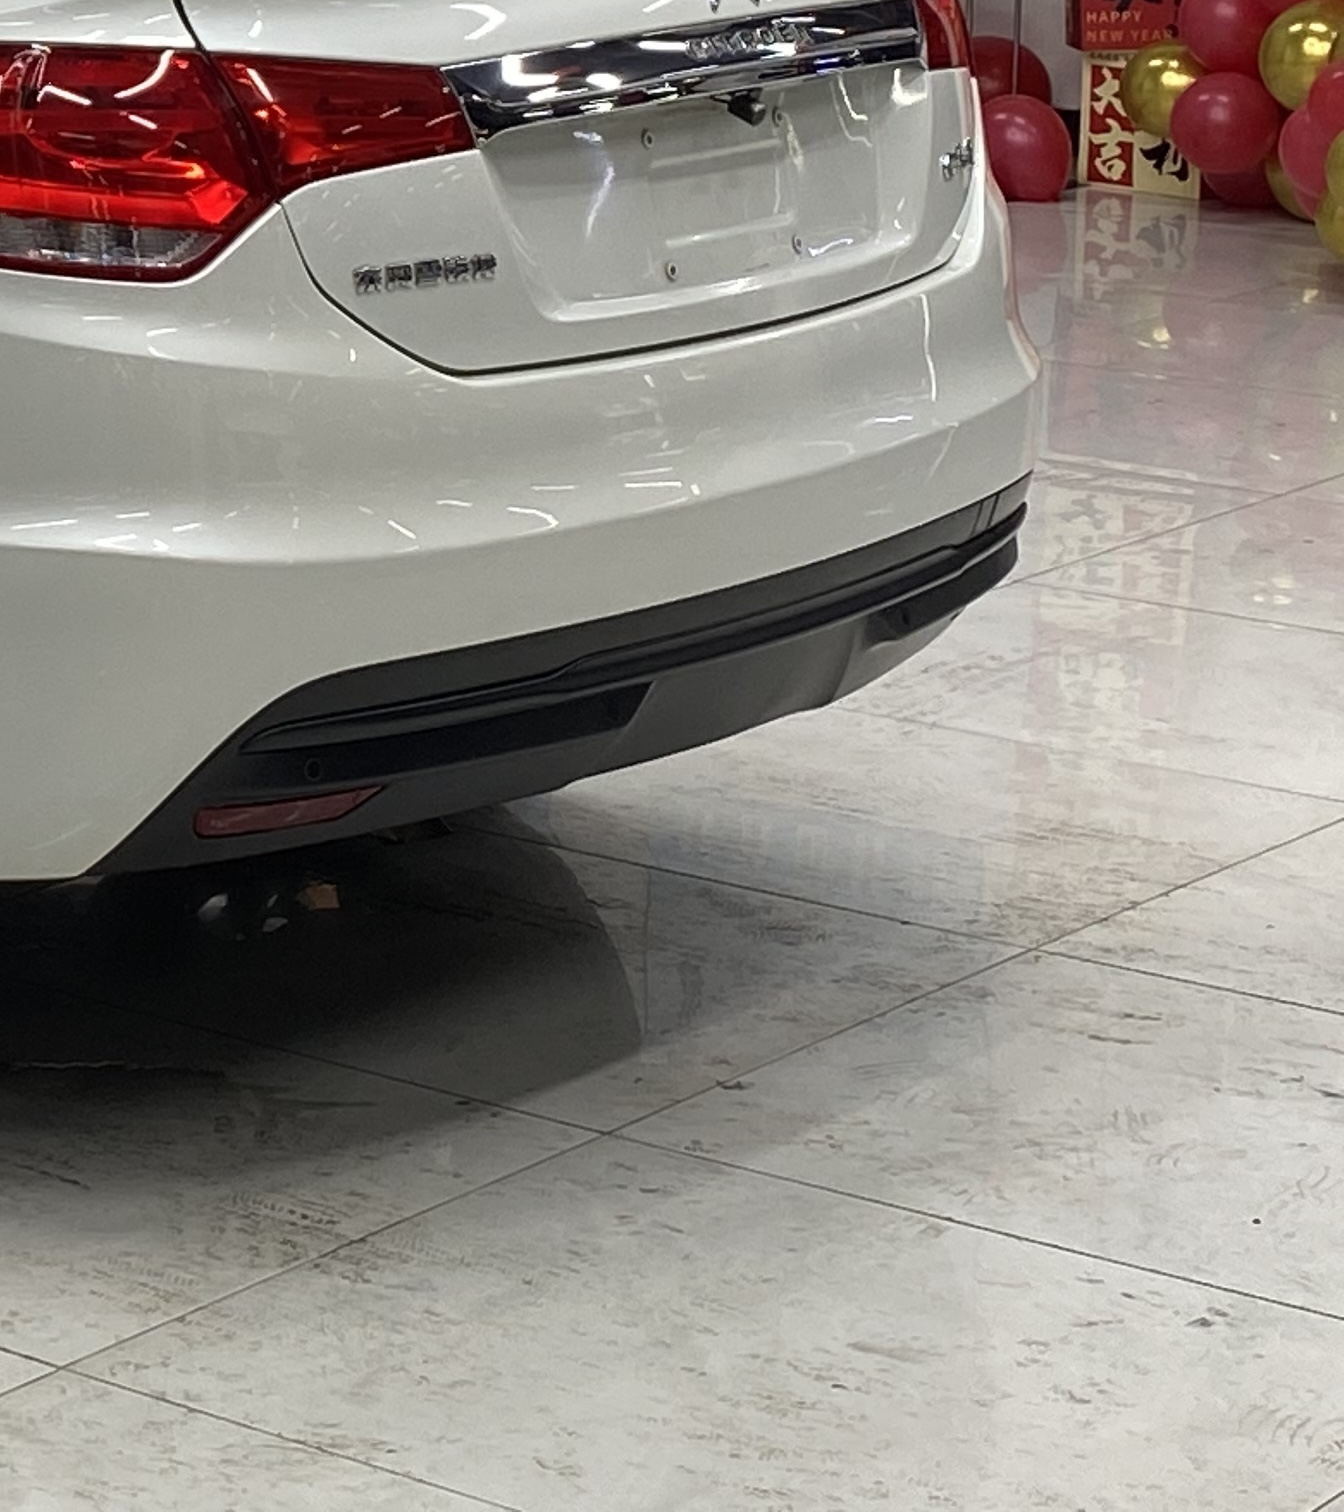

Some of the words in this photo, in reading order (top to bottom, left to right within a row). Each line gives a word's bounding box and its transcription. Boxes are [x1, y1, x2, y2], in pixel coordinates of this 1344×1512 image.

[1086, 10, 1143, 24] HAPPY
[1086, 30, 1124, 42] NEW
[1130, 29, 1174, 41] YEAR
